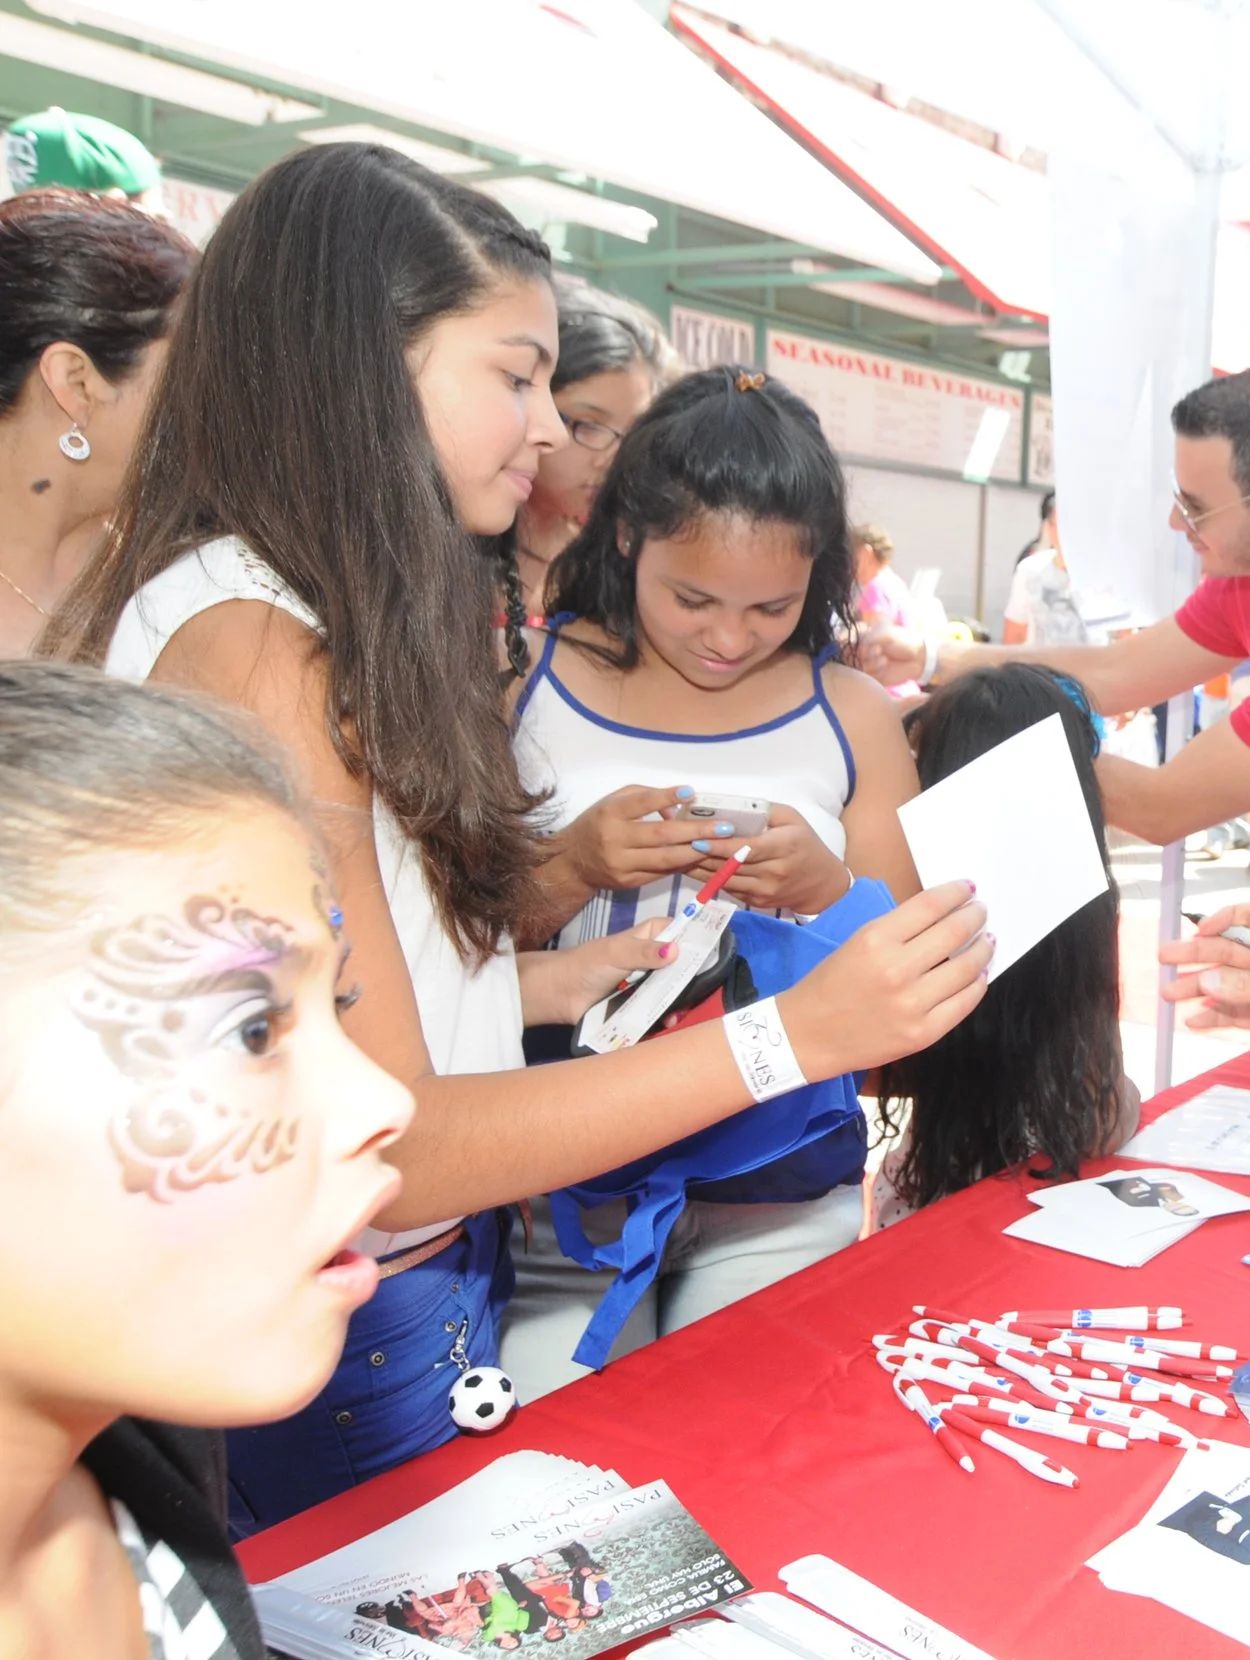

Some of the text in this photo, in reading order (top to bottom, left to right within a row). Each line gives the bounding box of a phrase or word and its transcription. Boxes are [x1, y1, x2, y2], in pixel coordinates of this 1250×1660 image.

[772, 339, 1022, 409] SEASONAL BEVERAGES
[597, 1570, 735, 1633] 23 DE SEPTIEMBRE
[620, 1579, 745, 1635] El Albergue
